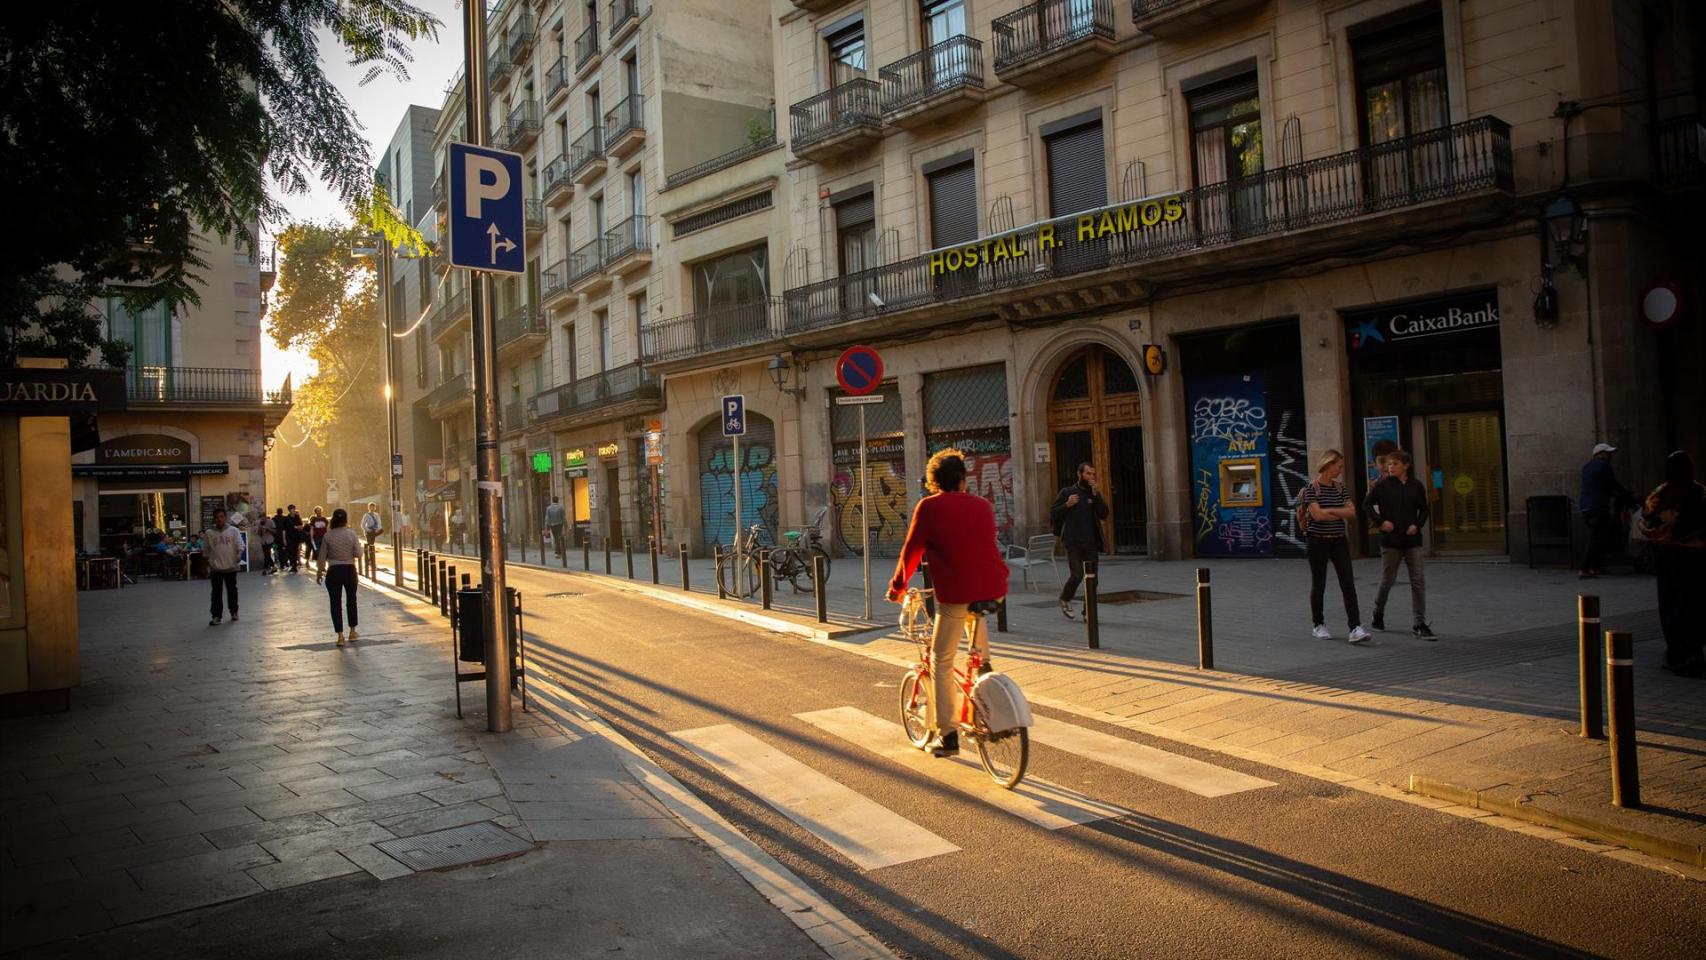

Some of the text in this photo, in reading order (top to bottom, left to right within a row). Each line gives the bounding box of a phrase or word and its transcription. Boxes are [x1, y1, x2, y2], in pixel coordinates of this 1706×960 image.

[464, 153, 511, 219] P
[930, 196, 1184, 276] HOSTAL R. RAMOS
[1390, 302, 1499, 335] CaixaBank
[728, 401, 738, 416] P
[104, 448, 181, 458] L'AMERICANO
